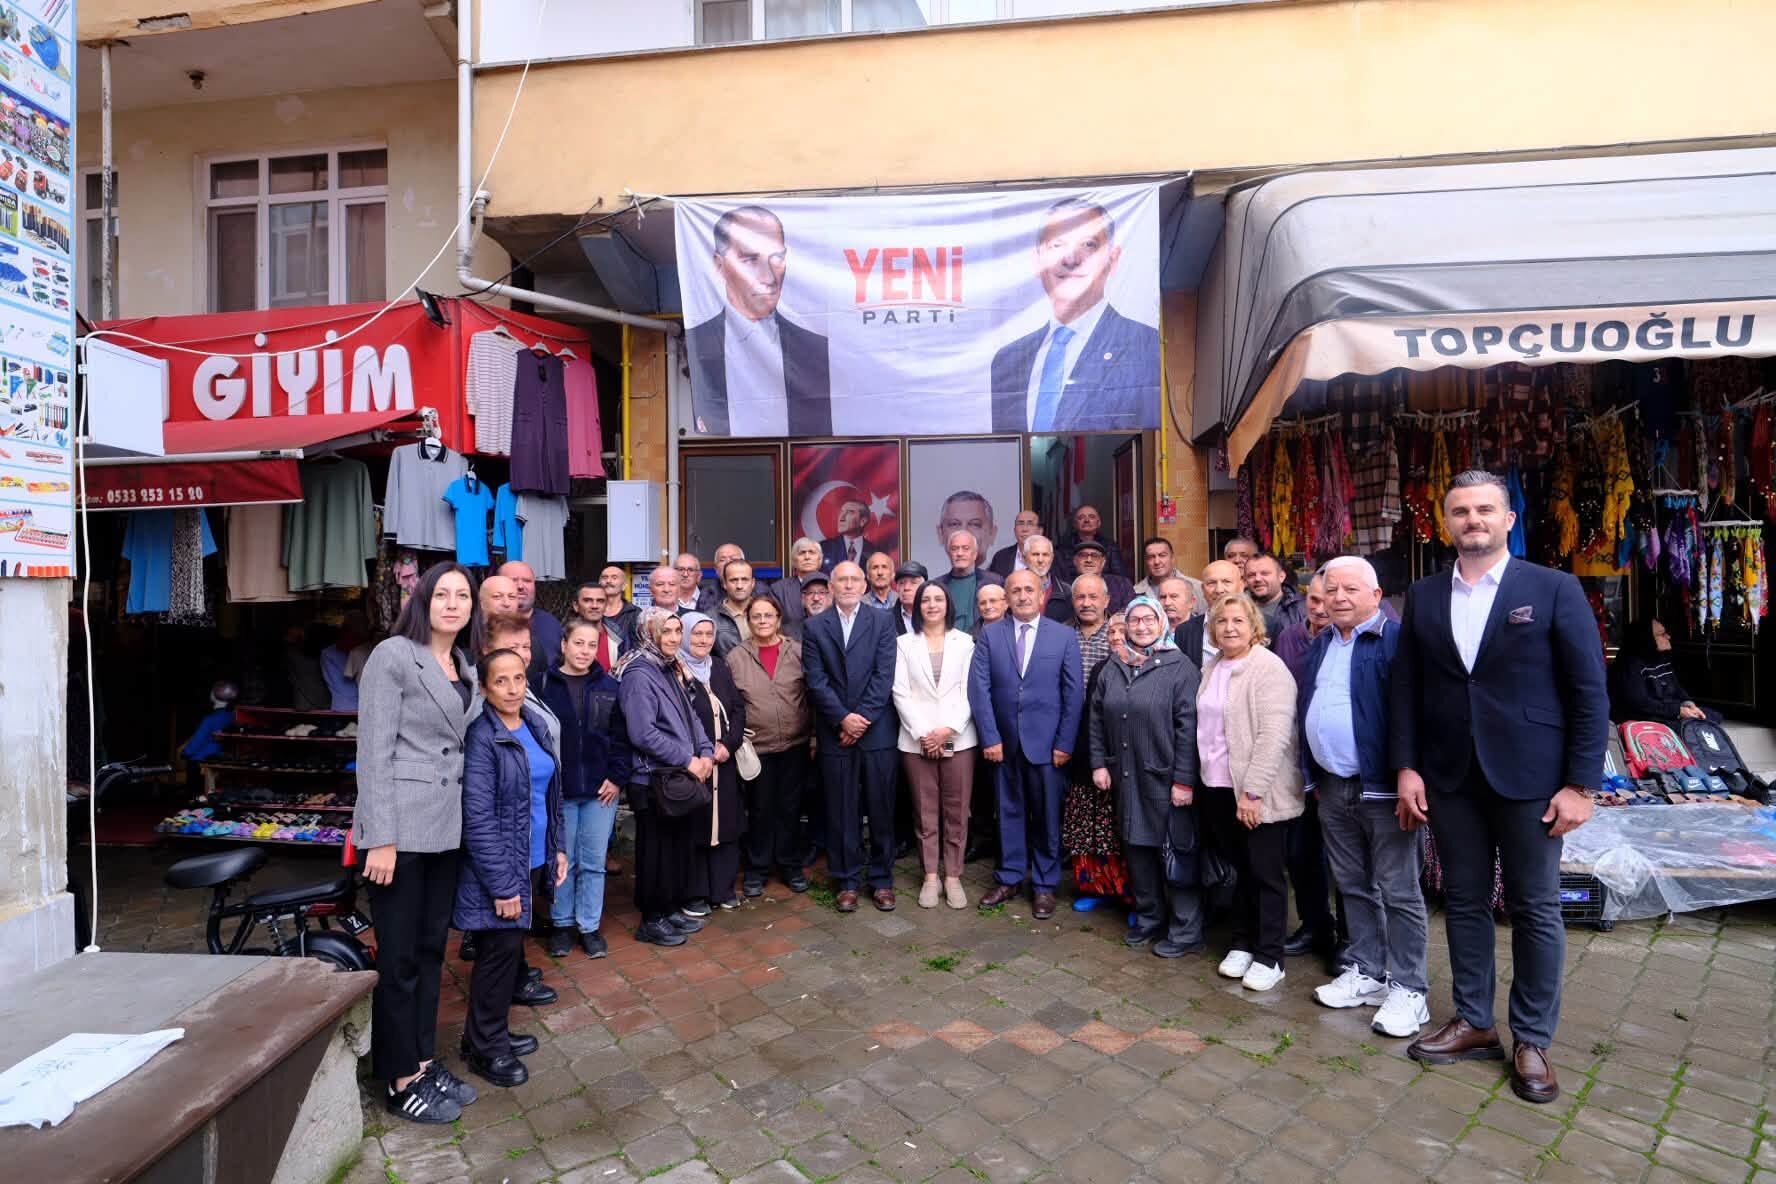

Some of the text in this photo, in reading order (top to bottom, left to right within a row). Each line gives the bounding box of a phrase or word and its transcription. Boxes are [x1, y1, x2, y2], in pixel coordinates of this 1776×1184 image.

[1394, 312, 1756, 358] TOPÇUOĞLU
[193, 329, 415, 421] GİYİM
[107, 489, 137, 503] 0533
[140, 488, 164, 502] 253
[169, 487, 184, 501] 15
[187, 486, 204, 500] 20
